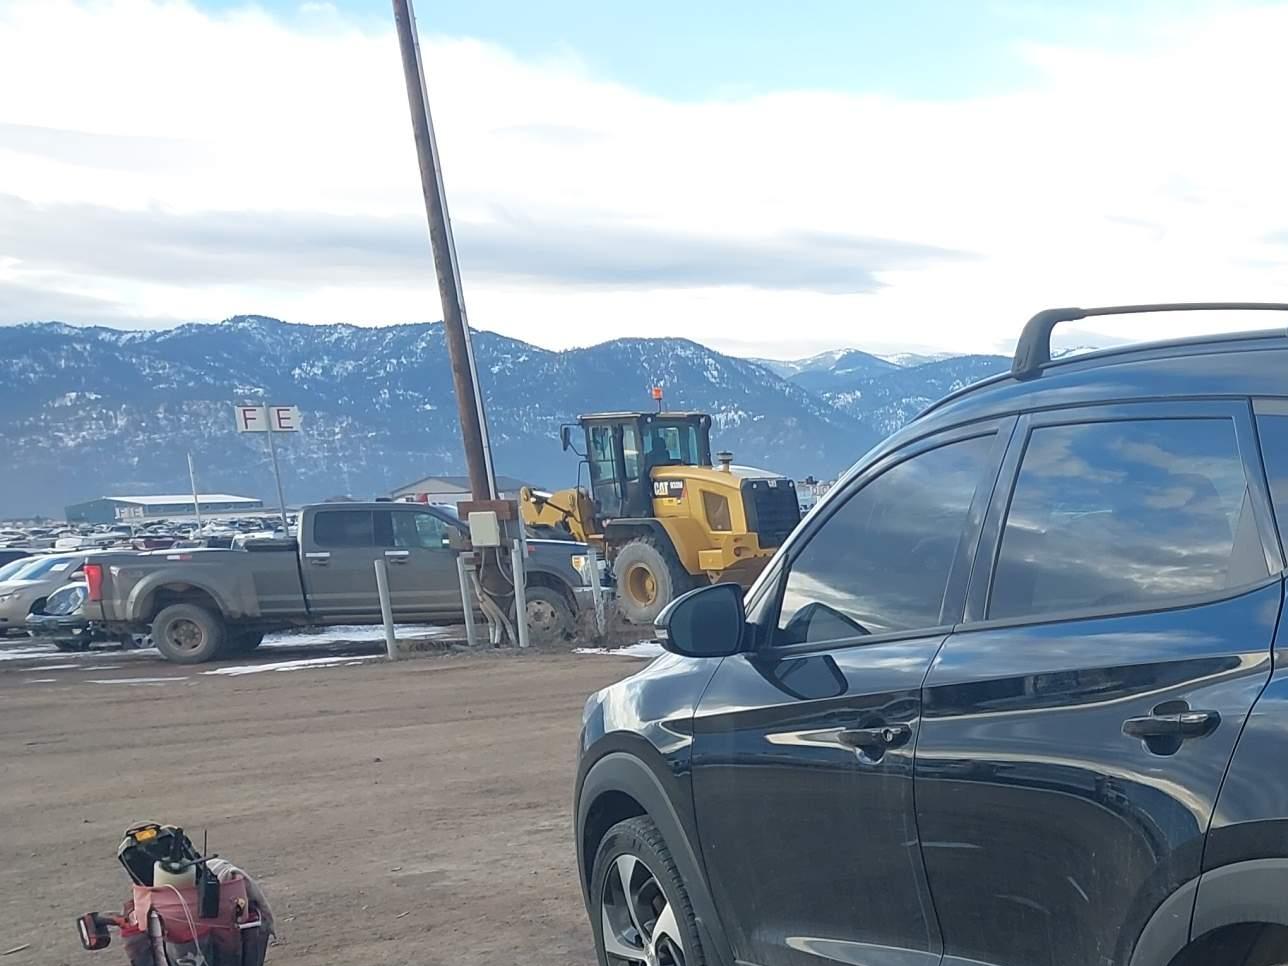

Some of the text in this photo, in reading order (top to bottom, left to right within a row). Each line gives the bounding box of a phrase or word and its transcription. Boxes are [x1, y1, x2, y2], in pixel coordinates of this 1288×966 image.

[242, 409, 293, 429] F E
[654, 481, 669, 495] CAT
